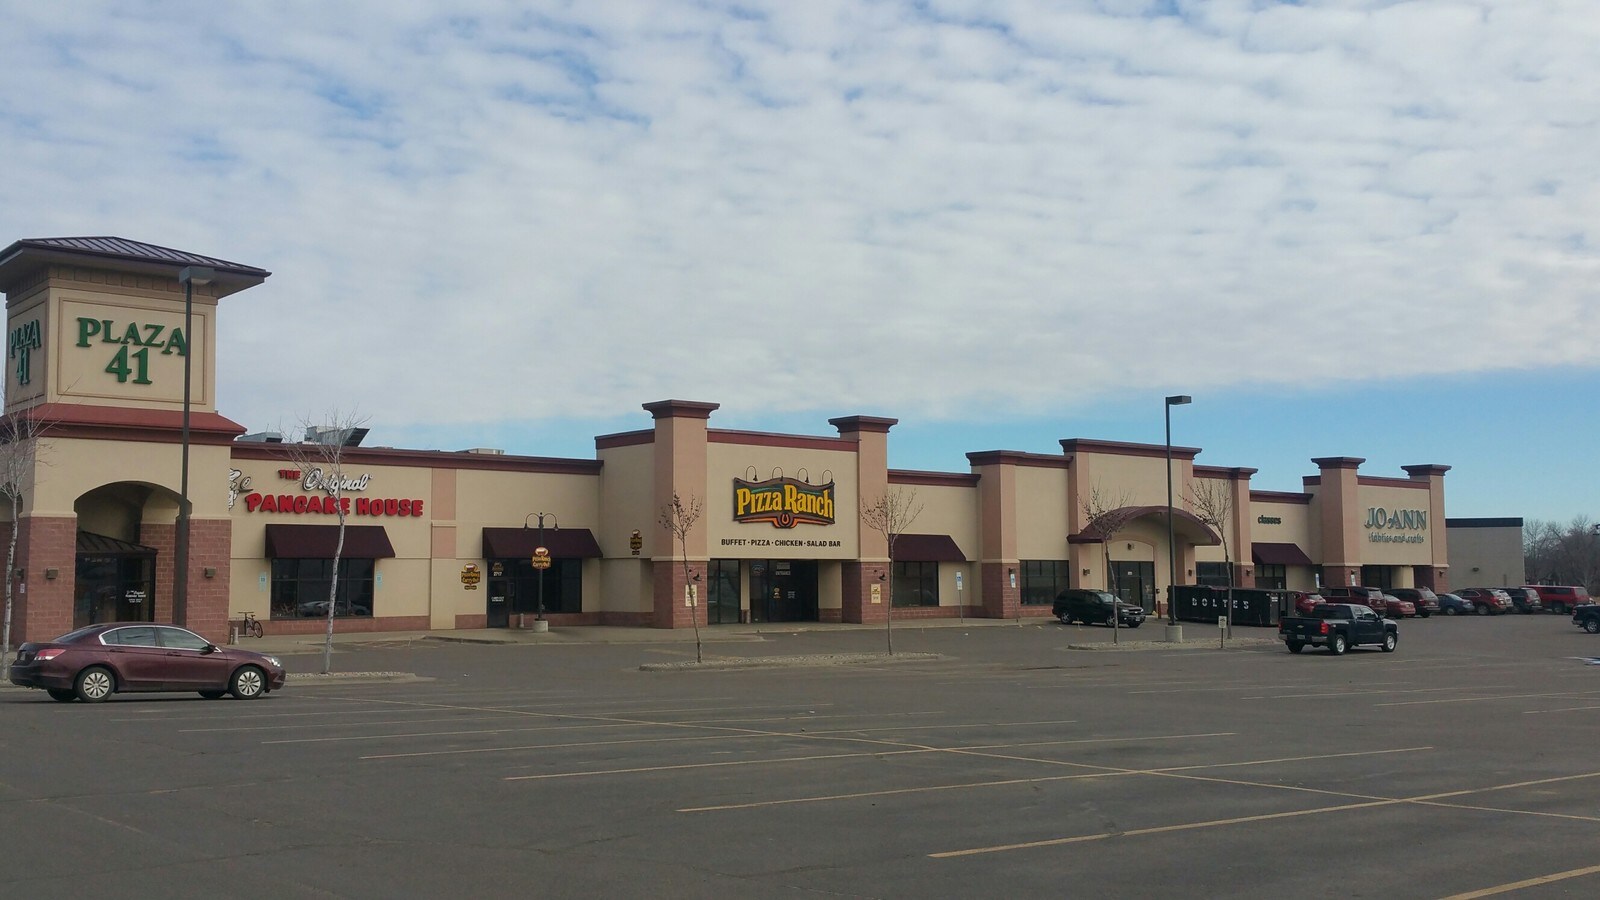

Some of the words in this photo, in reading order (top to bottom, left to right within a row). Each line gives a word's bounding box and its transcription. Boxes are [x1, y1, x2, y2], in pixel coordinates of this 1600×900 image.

[10, 319, 41, 359] PLAZA
[76, 317, 186, 356] PLAZA
[16, 348, 31, 386] 41
[105, 345, 153, 385] 41
[278, 469, 301, 480] THE
[303, 467, 370, 495] Original
[245, 493, 351, 515] PANCAKE
[356, 497, 424, 517] HOUSE
[736, 488, 782, 516] Pizza
[784, 484, 834, 519] Ranch
[721, 538, 746, 546] BUFFET
[774, 539, 803, 547] CHICKEN
